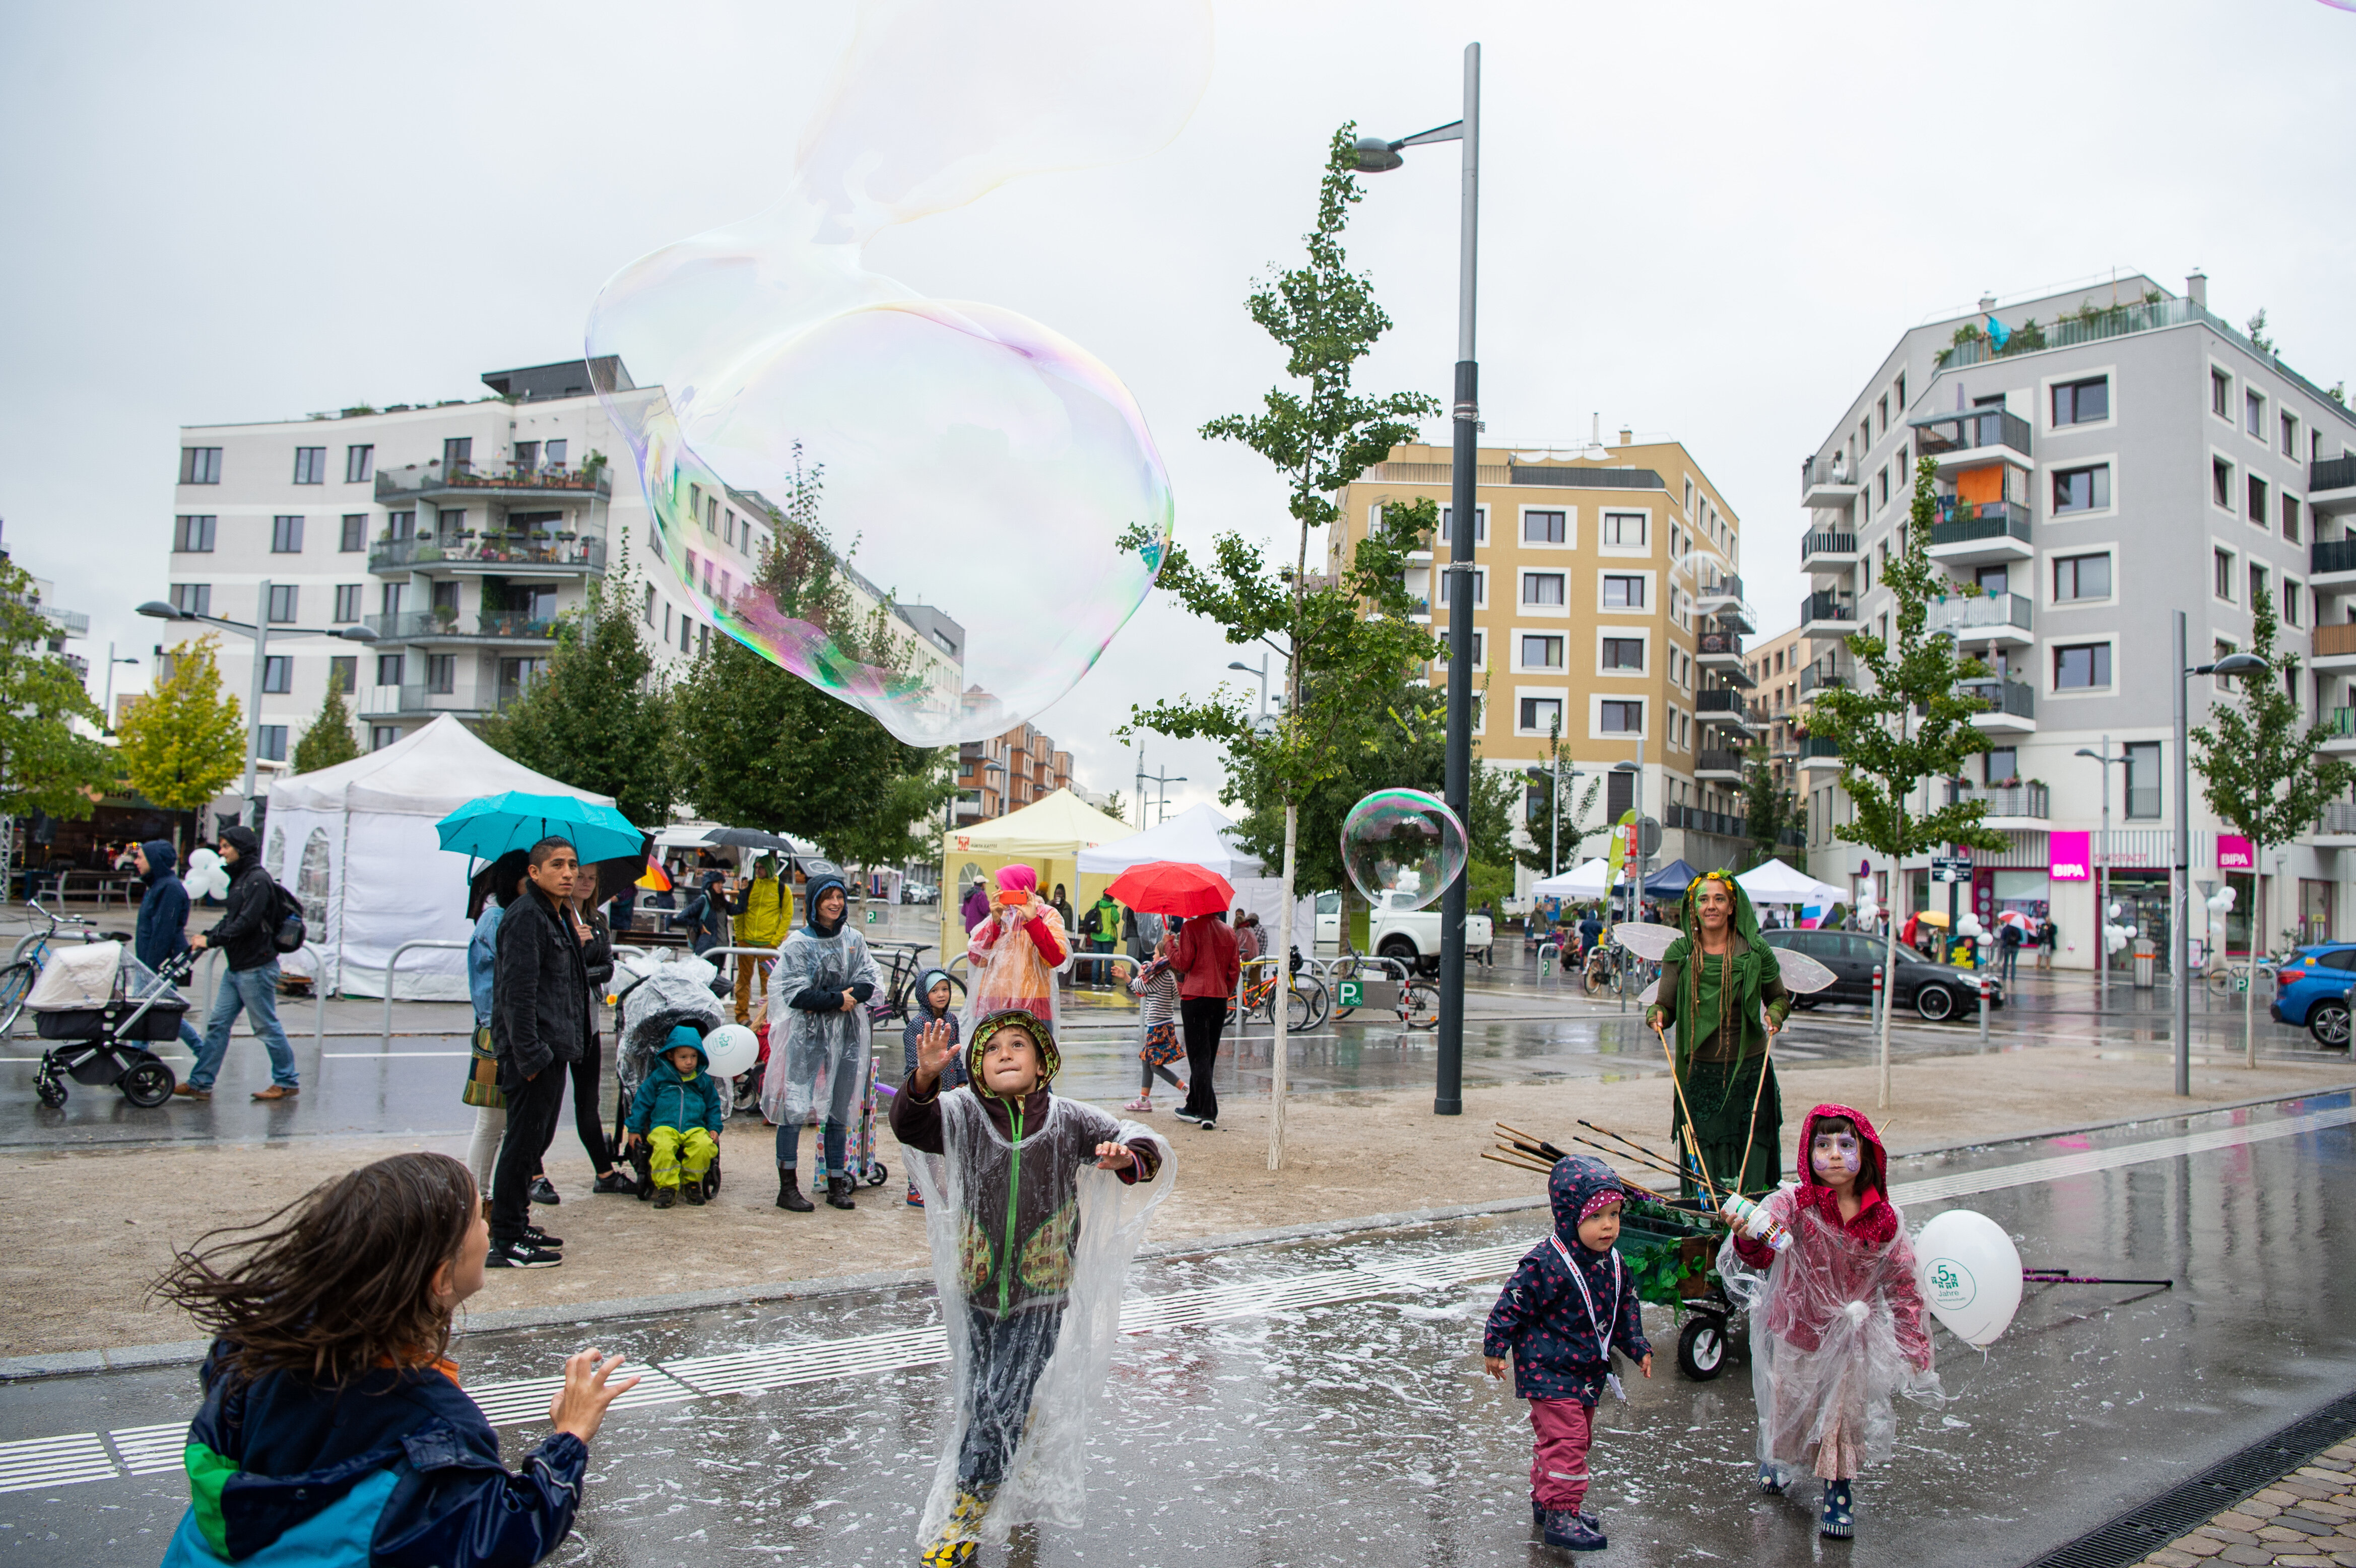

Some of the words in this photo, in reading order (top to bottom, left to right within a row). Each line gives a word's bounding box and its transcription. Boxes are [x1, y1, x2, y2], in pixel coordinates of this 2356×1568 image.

[2220, 853, 2248, 865] BIPA
[2053, 864, 2085, 877] BIPA
[867, 911, 875, 923] P
[1543, 961, 1548, 975] P
[2237, 978, 2247, 991] P
[1340, 983, 1357, 1004] P
[1938, 1265, 1949, 1281] 5
